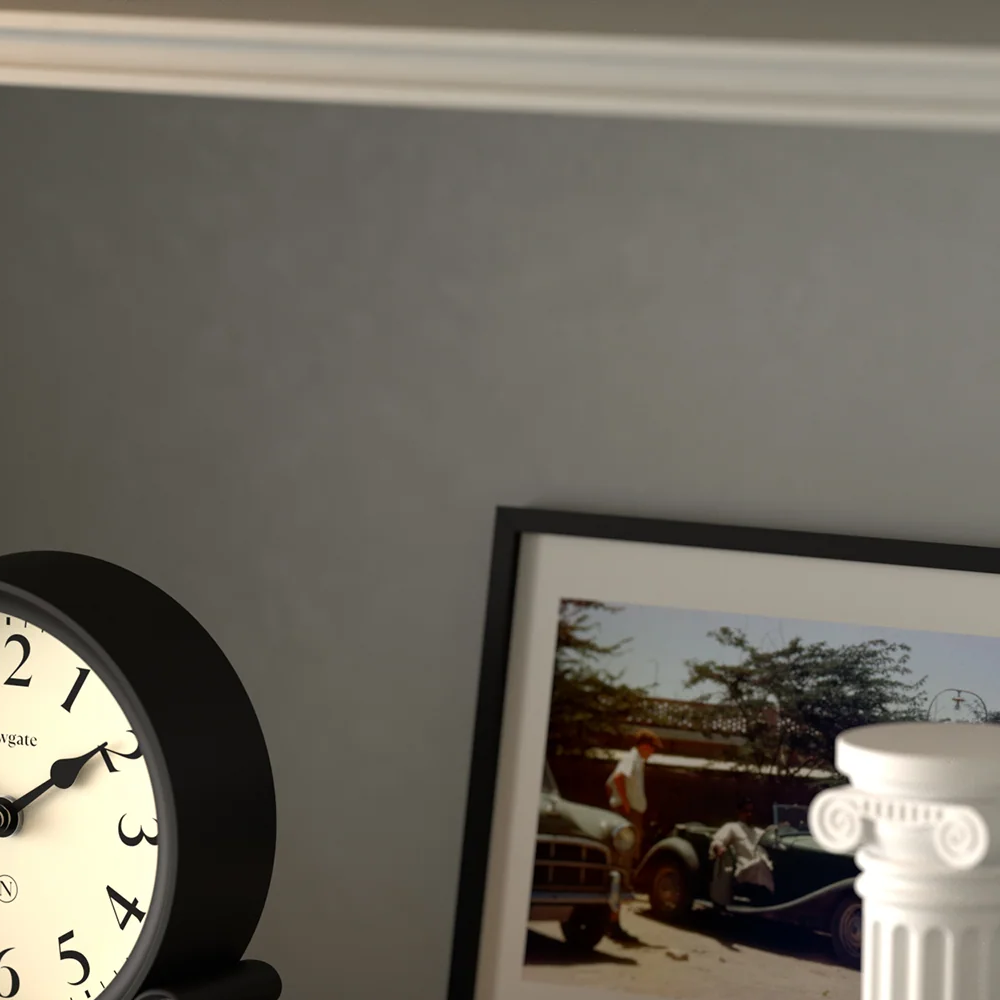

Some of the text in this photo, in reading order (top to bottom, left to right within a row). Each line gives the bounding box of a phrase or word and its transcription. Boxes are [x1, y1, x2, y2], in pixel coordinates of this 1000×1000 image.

[60, 666, 91, 713] 1
[98, 730, 144, 773] 2
[118, 813, 159, 846] 3
[106, 885, 146, 930] 4
[58, 930, 91, 985] 5
